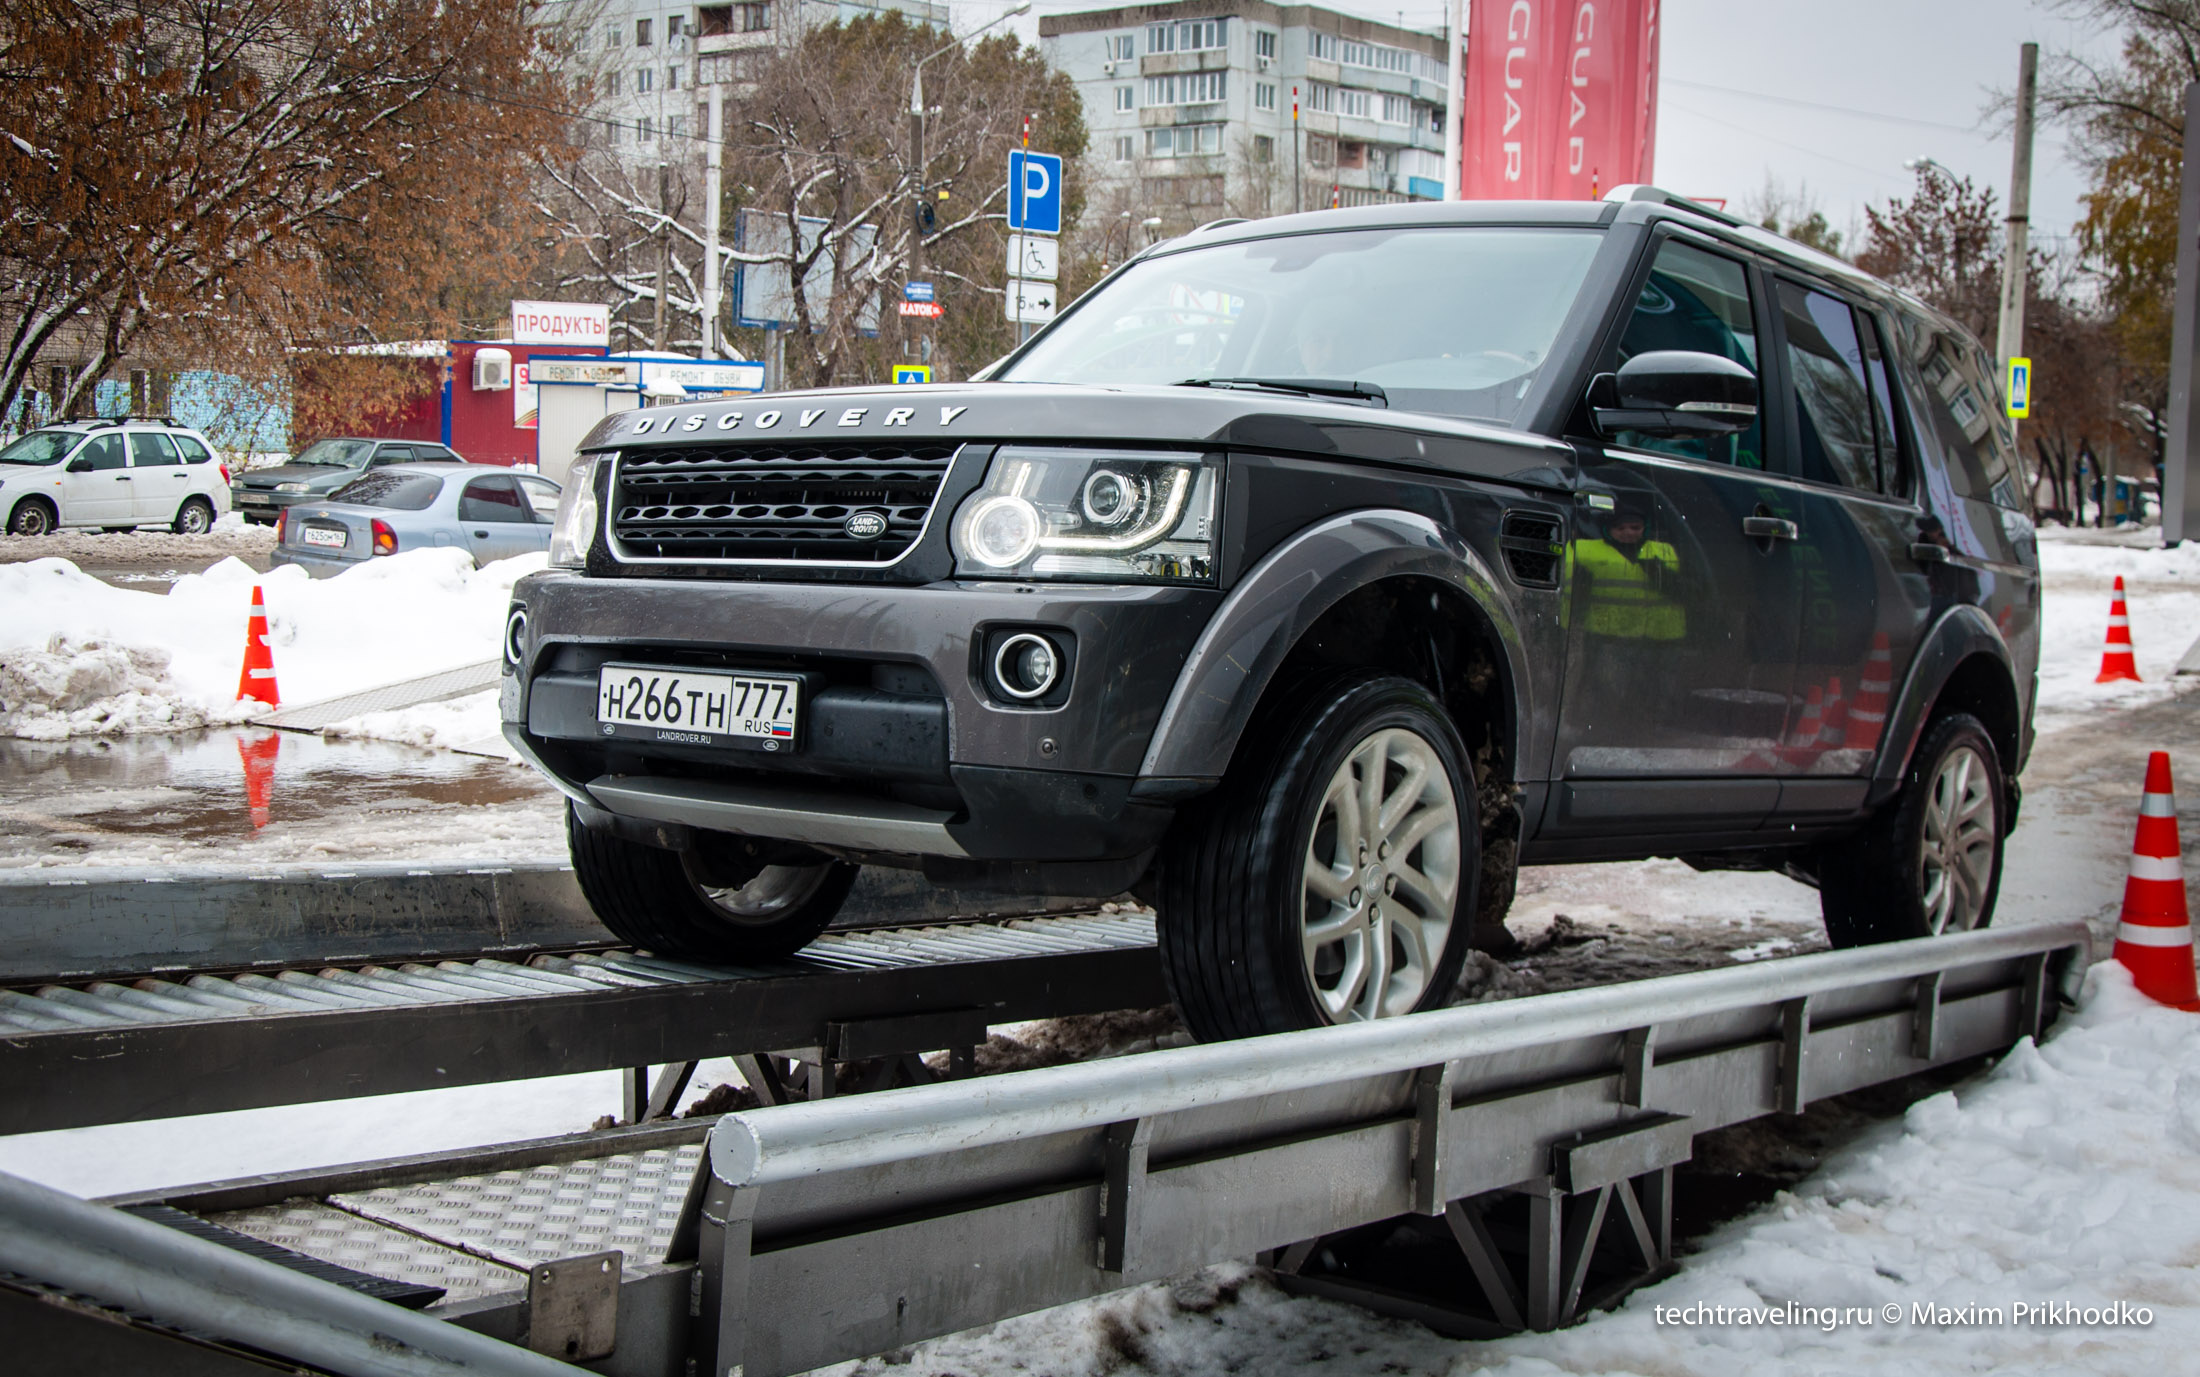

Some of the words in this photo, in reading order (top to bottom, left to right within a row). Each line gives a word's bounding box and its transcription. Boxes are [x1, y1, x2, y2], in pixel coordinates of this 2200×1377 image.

[1021, 161, 1050, 221] P
[900, 302, 933, 316] КАТОК
[517, 313, 606, 336] ПРОДУКТЫ
[549, 366, 581, 380] РЕМОНТ
[670, 370, 705, 384] РЕМОНТ
[713, 371, 742, 385] ОБУВИ
[632, 406, 968, 435] DISCOVERY
[852, 517, 874, 526] LAND
[852, 525, 879, 534] ROVER
[607, 676, 726, 729] H266TH
[735, 681, 789, 720] 777
[744, 719, 771, 734] RUS
[656, 730, 712, 745] LANDROVER.RU
